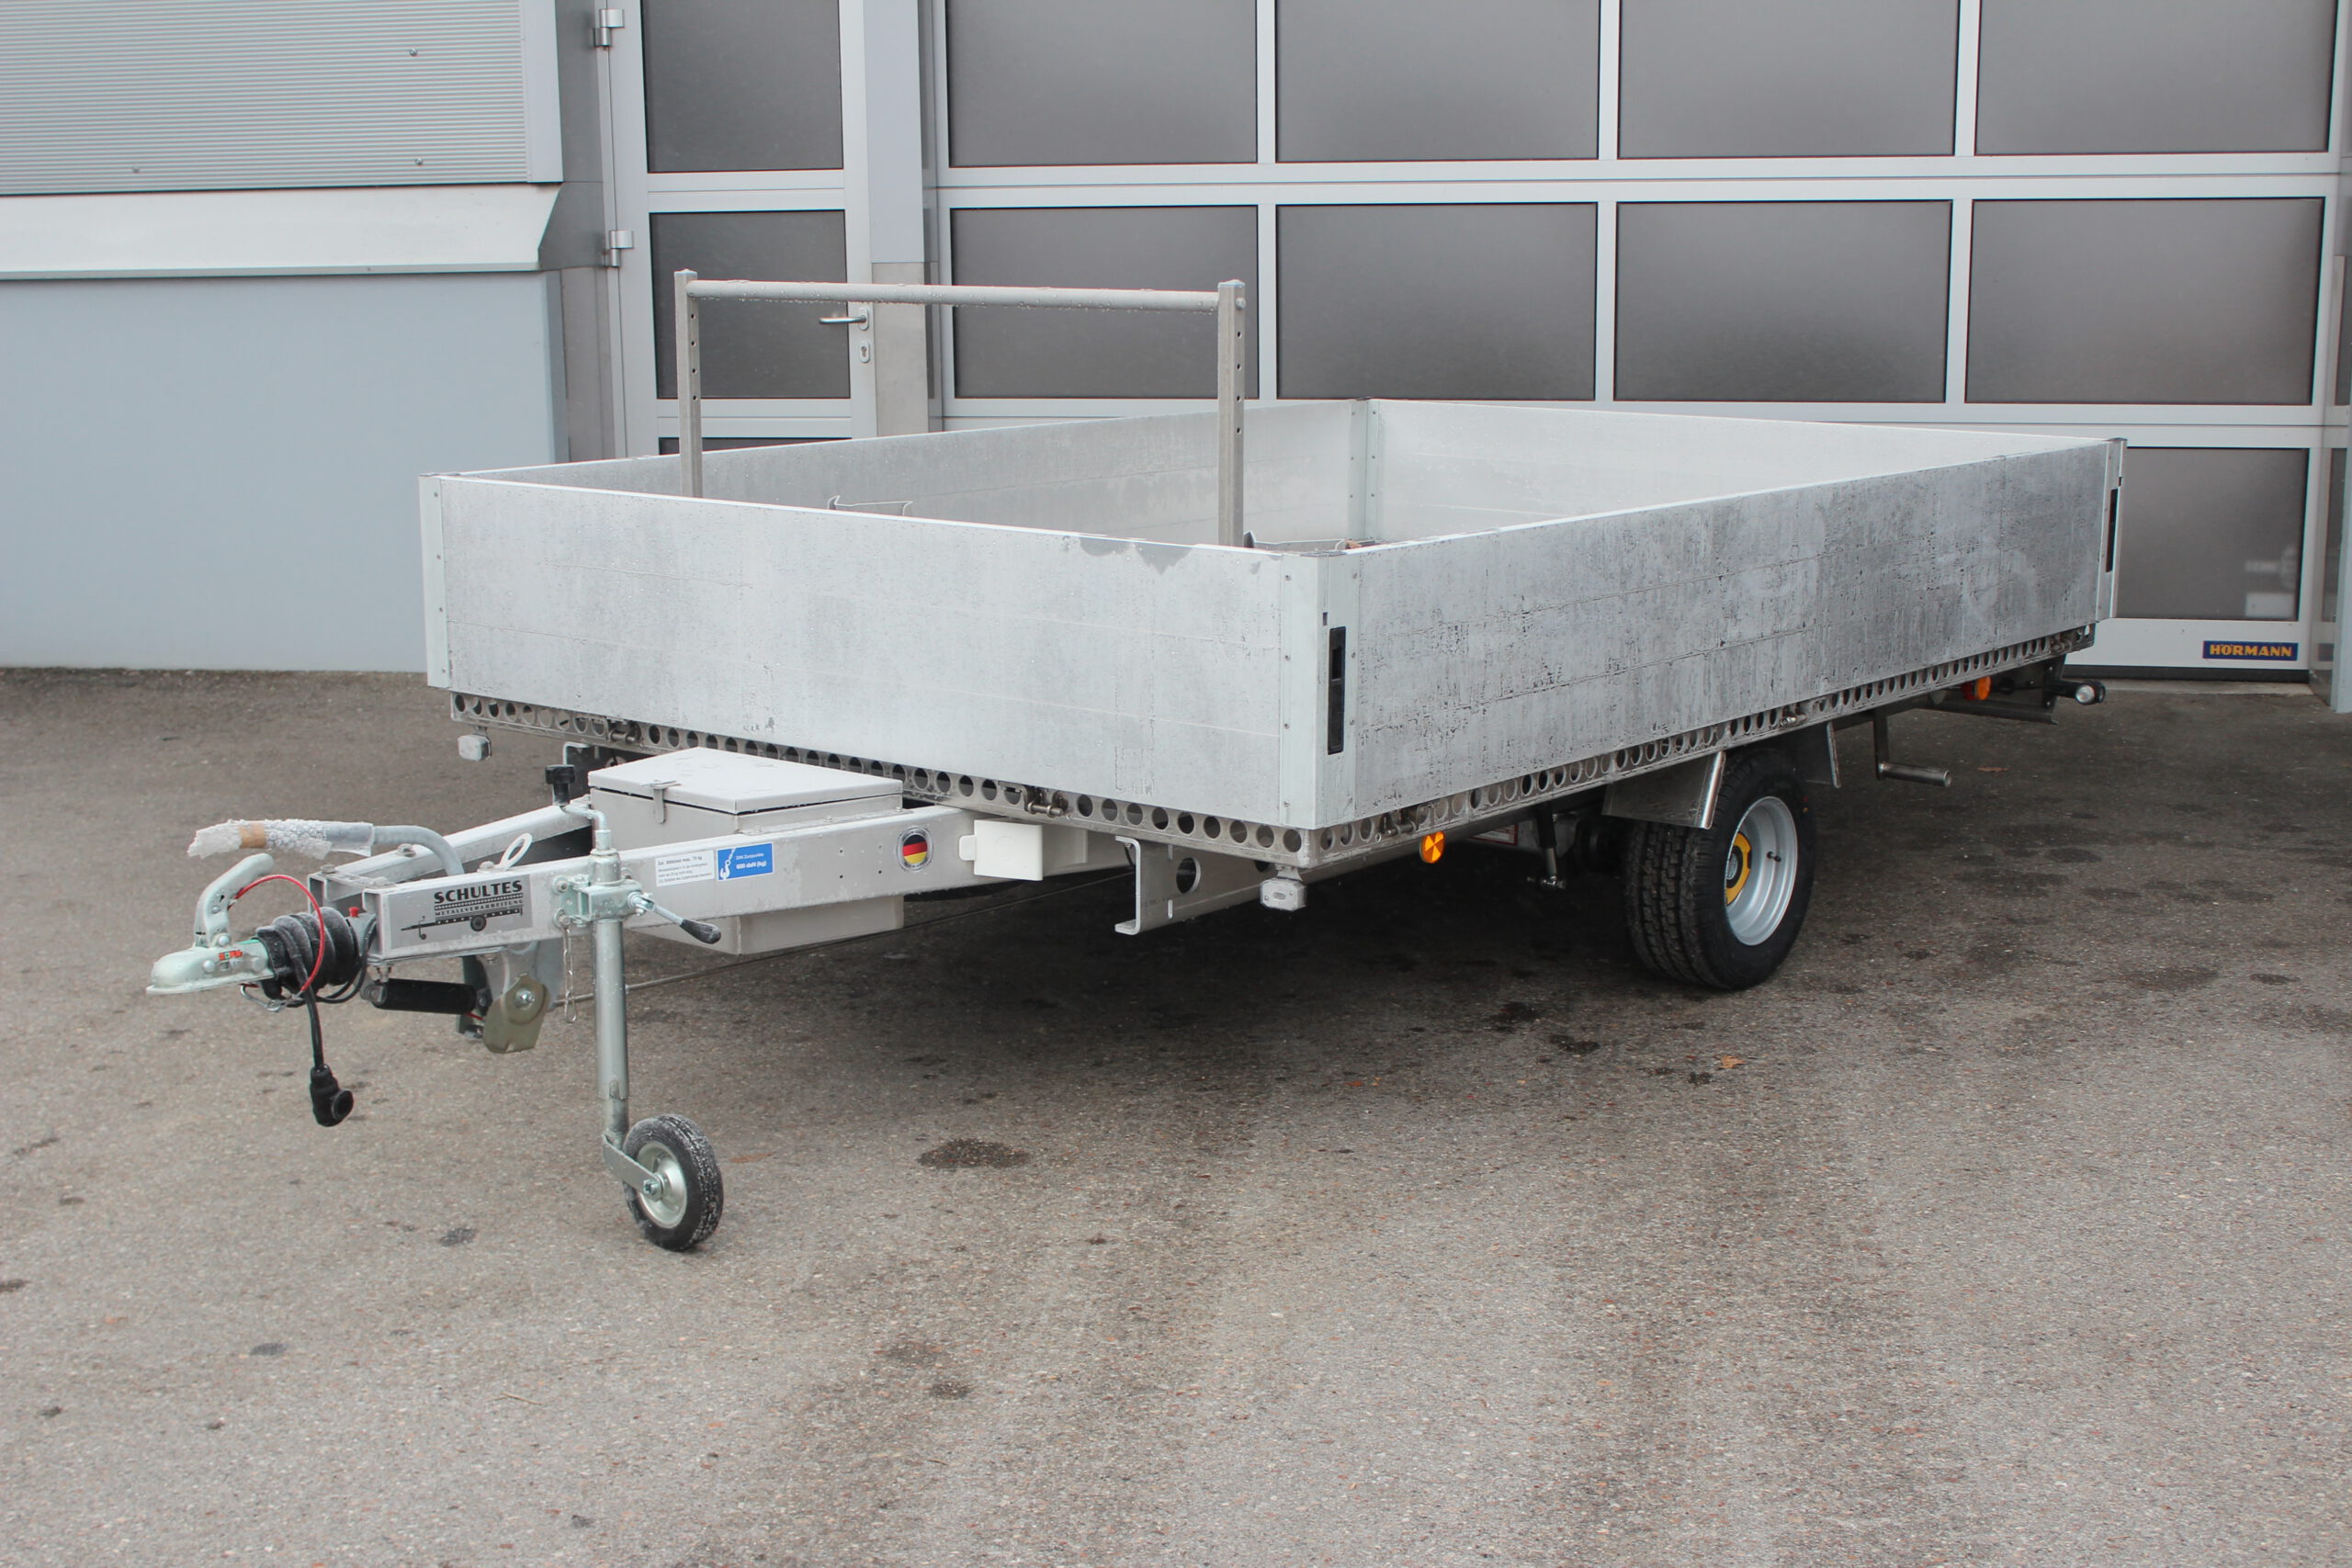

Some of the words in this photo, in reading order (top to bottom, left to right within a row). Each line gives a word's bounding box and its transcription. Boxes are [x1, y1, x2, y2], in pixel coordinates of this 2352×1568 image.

[2210, 644, 2292, 657] HÖRMANN
[434, 880, 523, 904] SCHULTES
[435, 899, 524, 916] METALLVERARBEITUNG
